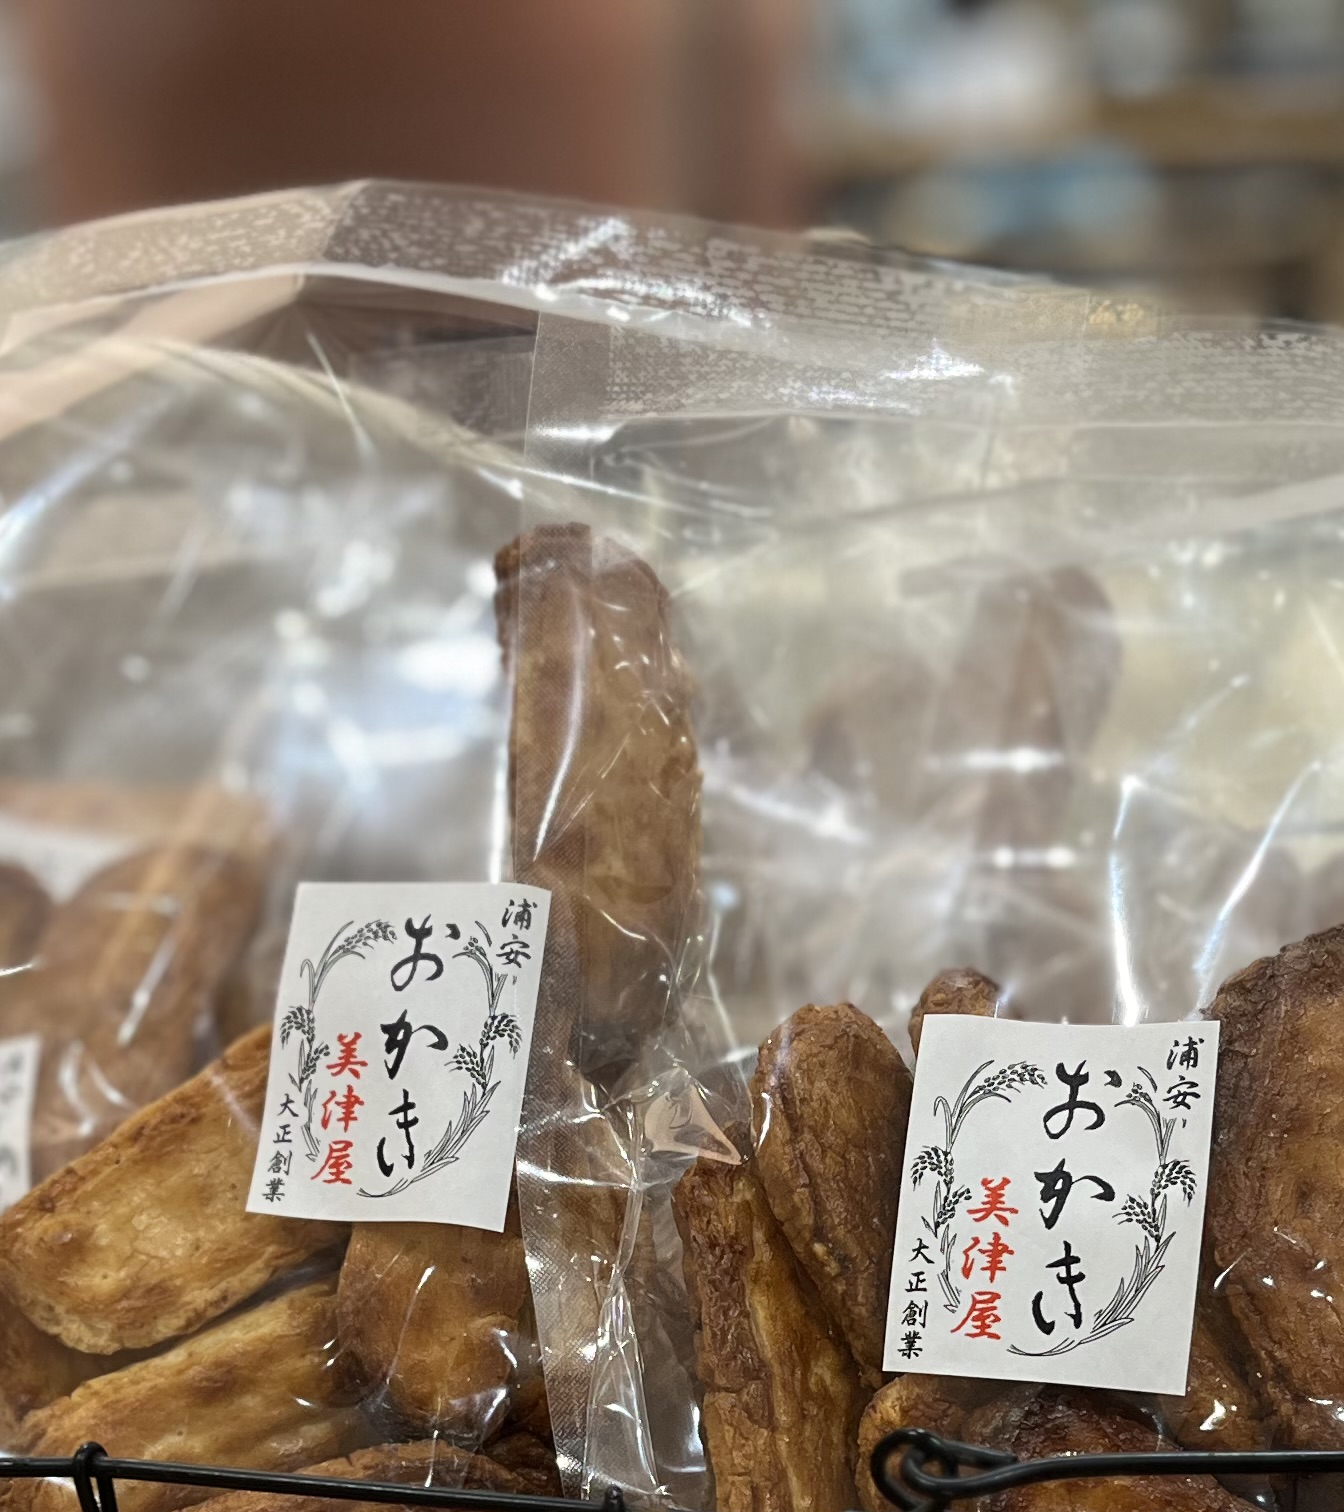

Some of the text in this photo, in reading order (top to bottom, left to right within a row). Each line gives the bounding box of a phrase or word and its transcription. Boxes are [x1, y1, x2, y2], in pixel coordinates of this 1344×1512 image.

[496, 898, 538, 968] 浦安
[310, 1032, 369, 1186] 美津屋
[376, 914, 461, 1178] おかき
[1162, 1037, 1205, 1110] 浦安
[262, 1094, 299, 1202] 大正創業
[1031, 1059, 1122, 1336] おかき
[897, 1238, 935, 1360] 大正創業
[950, 1177, 1019, 1340] 美津屋
